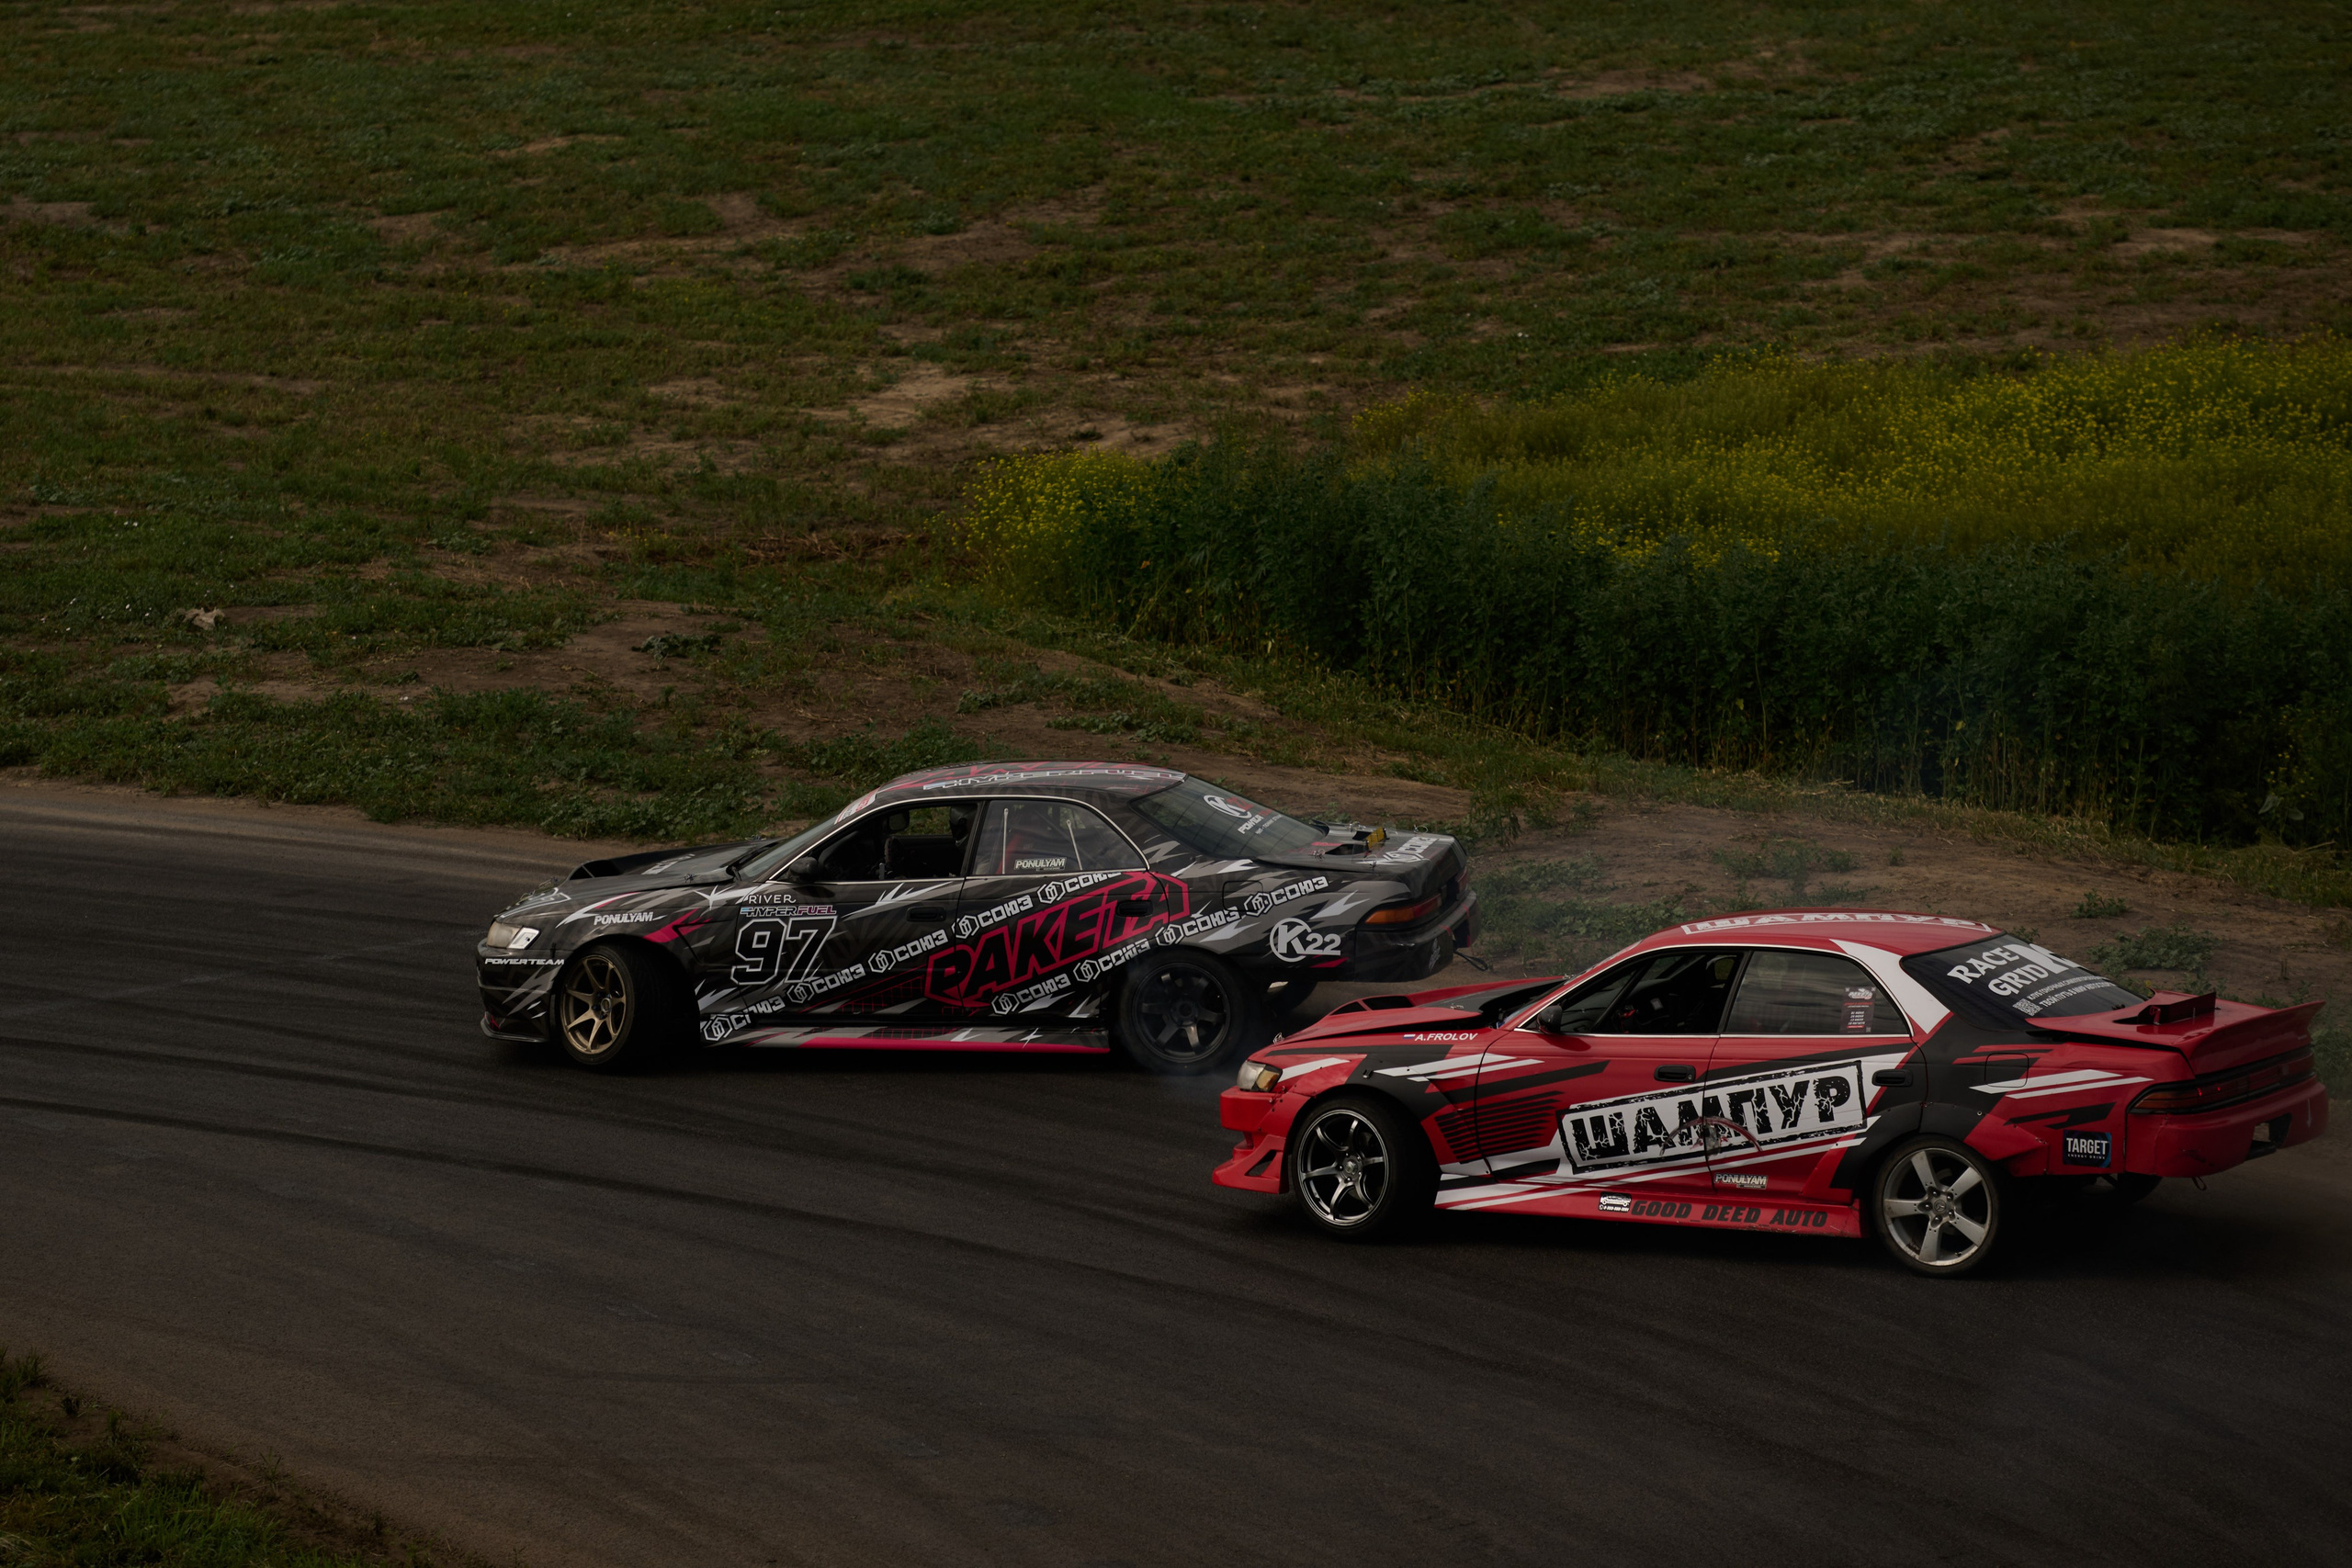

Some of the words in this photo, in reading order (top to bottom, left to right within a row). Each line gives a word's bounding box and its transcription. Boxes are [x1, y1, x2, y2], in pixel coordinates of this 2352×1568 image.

[1015, 858, 1066, 869] PONULYAM
[741, 905, 837, 917] HYPERFUEL
[749, 895, 797, 904] RIVER
[594, 911, 654, 926] PONULYAM
[730, 917, 837, 985] 97
[813, 964, 866, 994] СОЮЗ
[896, 929, 948, 962] СОЮЗ
[979, 895, 1034, 925] СОЮЗ
[1016, 973, 1071, 1005] СОЮЗ
[1098, 938, 1151, 972] СОЮЗ
[1182, 906, 1242, 936] СОЮЗ
[1271, 875, 1329, 906] СОЮЗ
[1270, 918, 1341, 963] K22
[1947, 947, 2019, 984] RACE
[1988, 964, 2049, 996] GRID
[1415, 1032, 1478, 1042] A.FROLOV
[1571, 1076, 1850, 1162] ШАМПУР
[2066, 1137, 2109, 1155] TARGET
[1715, 1173, 1767, 1185] PONULYAM
